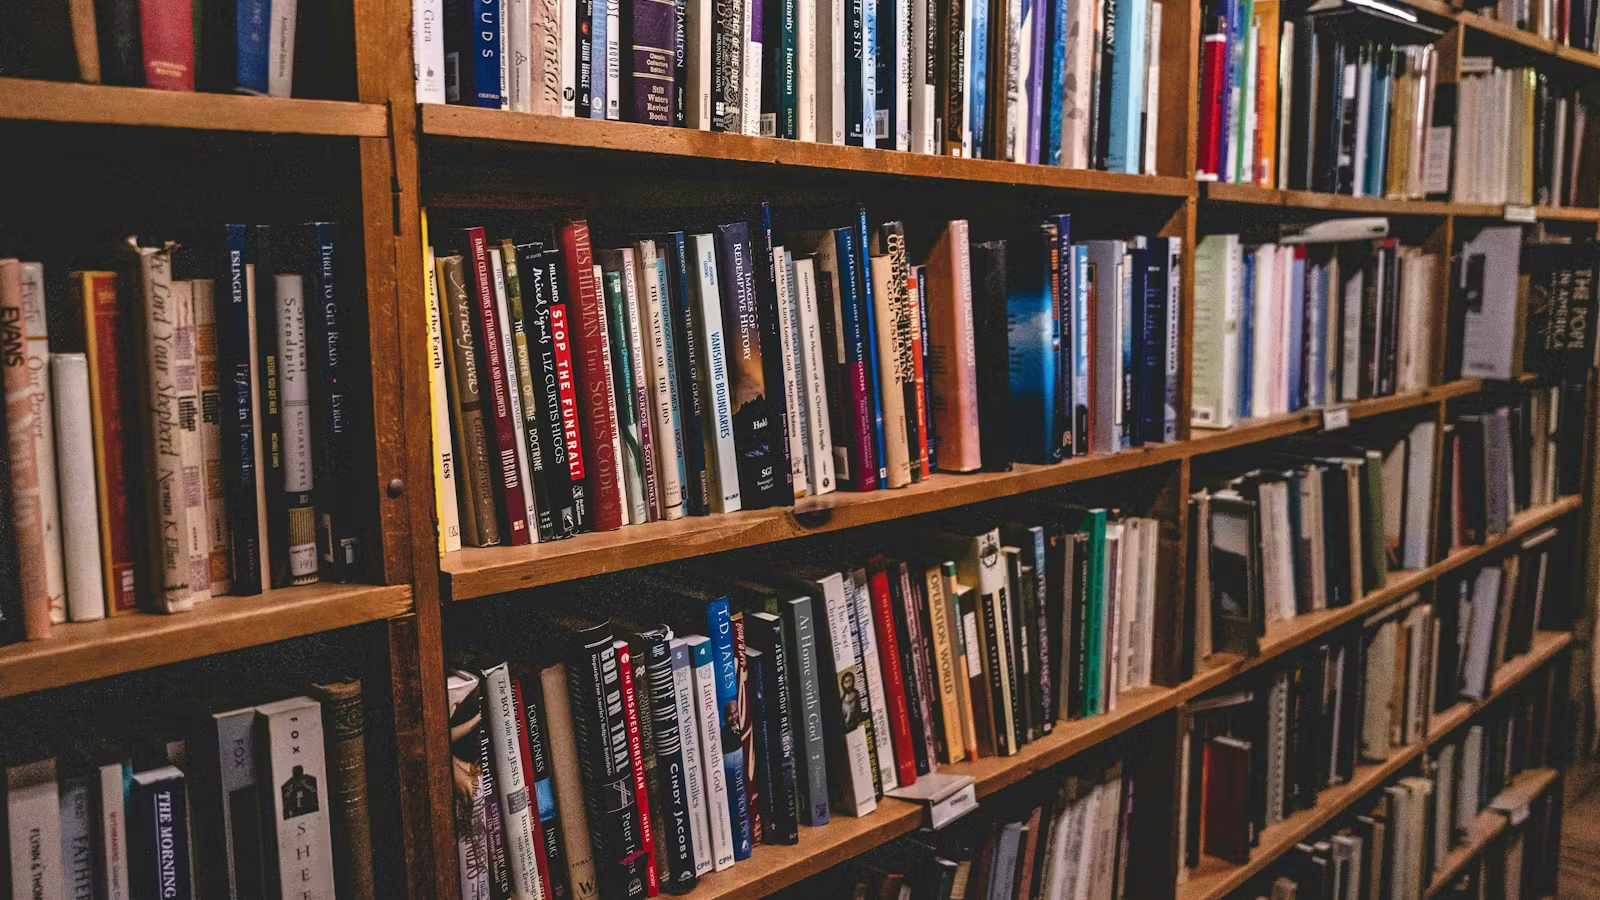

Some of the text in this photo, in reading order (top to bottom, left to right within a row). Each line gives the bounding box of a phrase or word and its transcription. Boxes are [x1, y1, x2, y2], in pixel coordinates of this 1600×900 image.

[423, 9, 435, 42] Gura
[676, 5, 685, 68] HAMILTON
[853, 20, 862, 59] to SIN
[927, 20, 935, 50] AND
[543, 17, 558, 104] WORLD'S
[581, 39, 590, 89] JOHN HAGEE
[731, 13, 740, 92] FACE OF THE DEEP
[867, 2, 875, 96] WAKING UP
[651, 85, 665, 94] Still
[785, 47, 793, 95] Hardman
[647, 93, 669, 104] Waters
[647, 102, 669, 113] Revival
[648, 111, 668, 121] Books
[230, 250, 242, 303] ESLINGER
[321, 242, 333, 280] THREE
[679, 241, 687, 274] Hoezee
[780, 271, 784, 285] Me
[962, 255, 970, 300] HUBBARD
[324, 283, 333, 298] TO
[549, 263, 559, 302] HILLIARD
[578, 268, 598, 338] HILLMAN
[625, 260, 637, 325] RECAPTURING
[733, 243, 751, 361] REDEMPTIVE HISTORY
[745, 272, 756, 329] IMAGES OF
[781, 287, 786, 297] Up
[532, 267, 552, 345] Mixed Signals
[1568, 269, 1591, 349] THE POPE
[1, 306, 24, 367] EVANS
[284, 298, 297, 383] Serendipity
[297, 307, 307, 373] Spiritual
[327, 332, 339, 366] READY
[474, 238, 507, 418] FAMILY CELEBRATIONS AT THANKSGIVING AND HALLOWEEN
[686, 327, 695, 366] RIDDLE
[887, 280, 904, 384] GOD USES INK
[963, 302, 975, 367] SCIENTOLOGY
[153, 332, 172, 375] Your
[634, 346, 645, 388] PRIMARY
[650, 286, 670, 425] THE NATURE OF THE LION
[690, 367, 697, 380] OF
[514, 320, 543, 472] THE POWER OF THE DOCTRINE
[552, 309, 581, 477] STOP THE FUNERAL!
[691, 383, 701, 417] GRACE
[711, 331, 730, 439] VANISHING BOUNDARIES
[542, 351, 565, 465] LIZ CURTIS HIGGS
[586, 348, 613, 497] THE SOUL'S CODE
[638, 387, 648, 428] PURPOSE
[297, 411, 305, 457] RICHARD
[442, 452, 451, 479] Hess
[501, 449, 518, 489] HIBBARD
[643, 443, 654, 471] SCOTT
[647, 472, 657, 507] HINKLE
[717, 606, 735, 690] T.D. JAKES
[827, 599, 841, 661] Christendom
[841, 625, 850, 650] Next
[931, 574, 952, 694] OPERATION WORLD
[700, 648, 706, 656] 4
[703, 682, 712, 712] Little
[775, 643, 791, 758] JESUS WITHOUT RELIGION
[799, 616, 821, 742] At Home with God
[501, 696, 510, 718] BOY
[601, 647, 630, 773] GOD ON TRIAL
[680, 687, 689, 715] Little
[290, 715, 300, 755] FOX
[504, 719, 512, 735] who
[507, 737, 515, 754] met
[233, 738, 245, 769] FOX
[508, 755, 520, 786] JESUS
[626, 687, 637, 734] UNSAVED
[632, 737, 644, 789] CHRISTIAN
[642, 813, 650, 843] INSERRA
[686, 747, 695, 763] for
[710, 743, 720, 768] with
[852, 743, 865, 777] Jenkins
[527, 703, 558, 858] FORGIVENESS INRIG
[688, 765, 700, 809] Families
[713, 770, 723, 793] God
[670, 763, 687, 860] CINDY JACOBS
[157, 791, 177, 899] THE MORNING
[622, 812, 636, 874] Peter Irns
[718, 854, 732, 866] CPH
[696, 860, 710, 871] CPH
